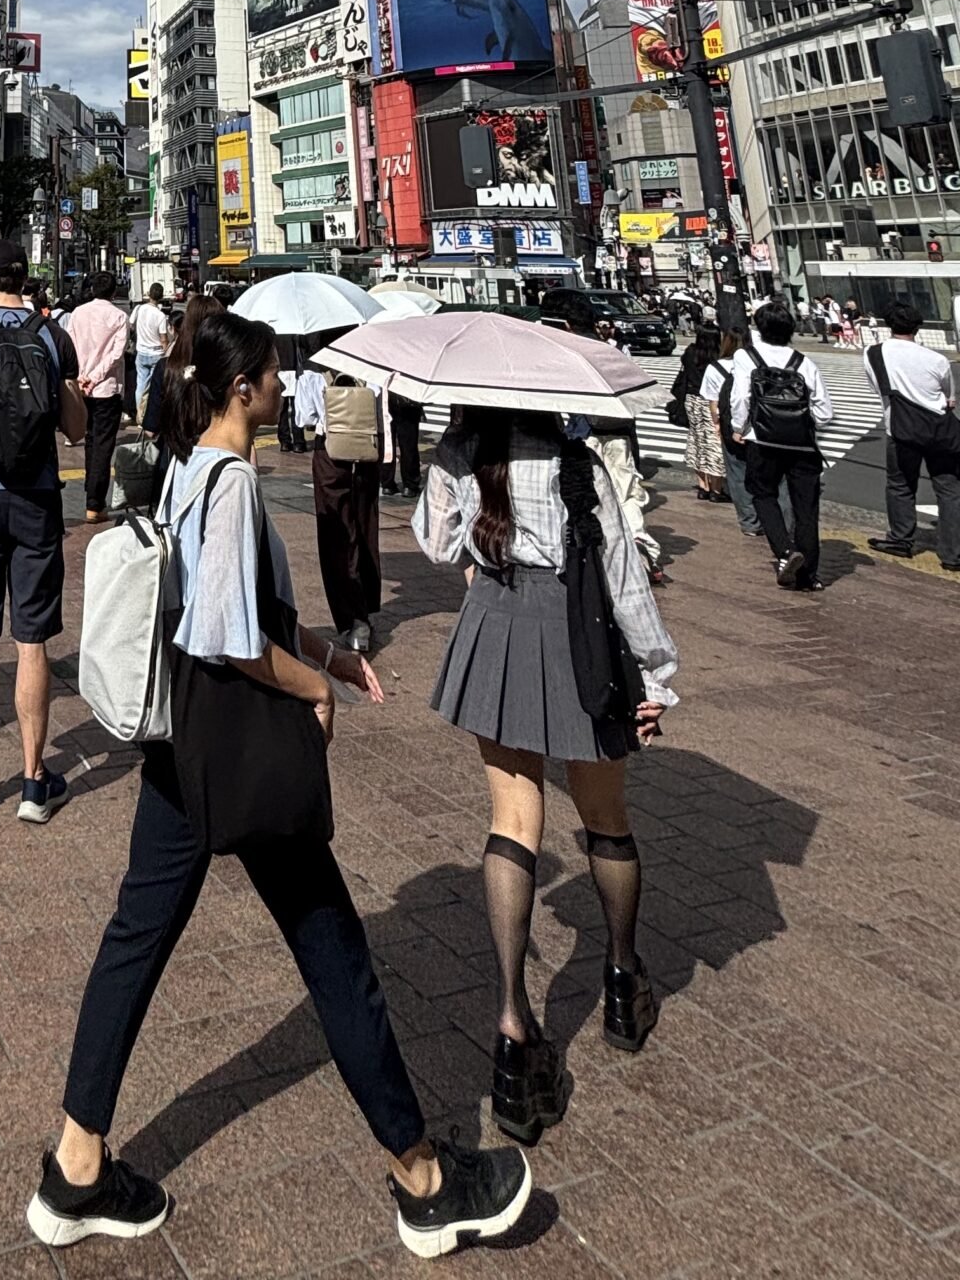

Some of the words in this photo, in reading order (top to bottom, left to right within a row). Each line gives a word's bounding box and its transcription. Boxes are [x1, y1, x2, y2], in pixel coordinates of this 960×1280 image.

[715, 118, 732, 170] カラオケ
[641, 169, 678, 179] クリニック
[649, 160, 677, 169] れいわ
[476, 179, 557, 207] DMM
[813, 174, 960, 200] STARBUC
